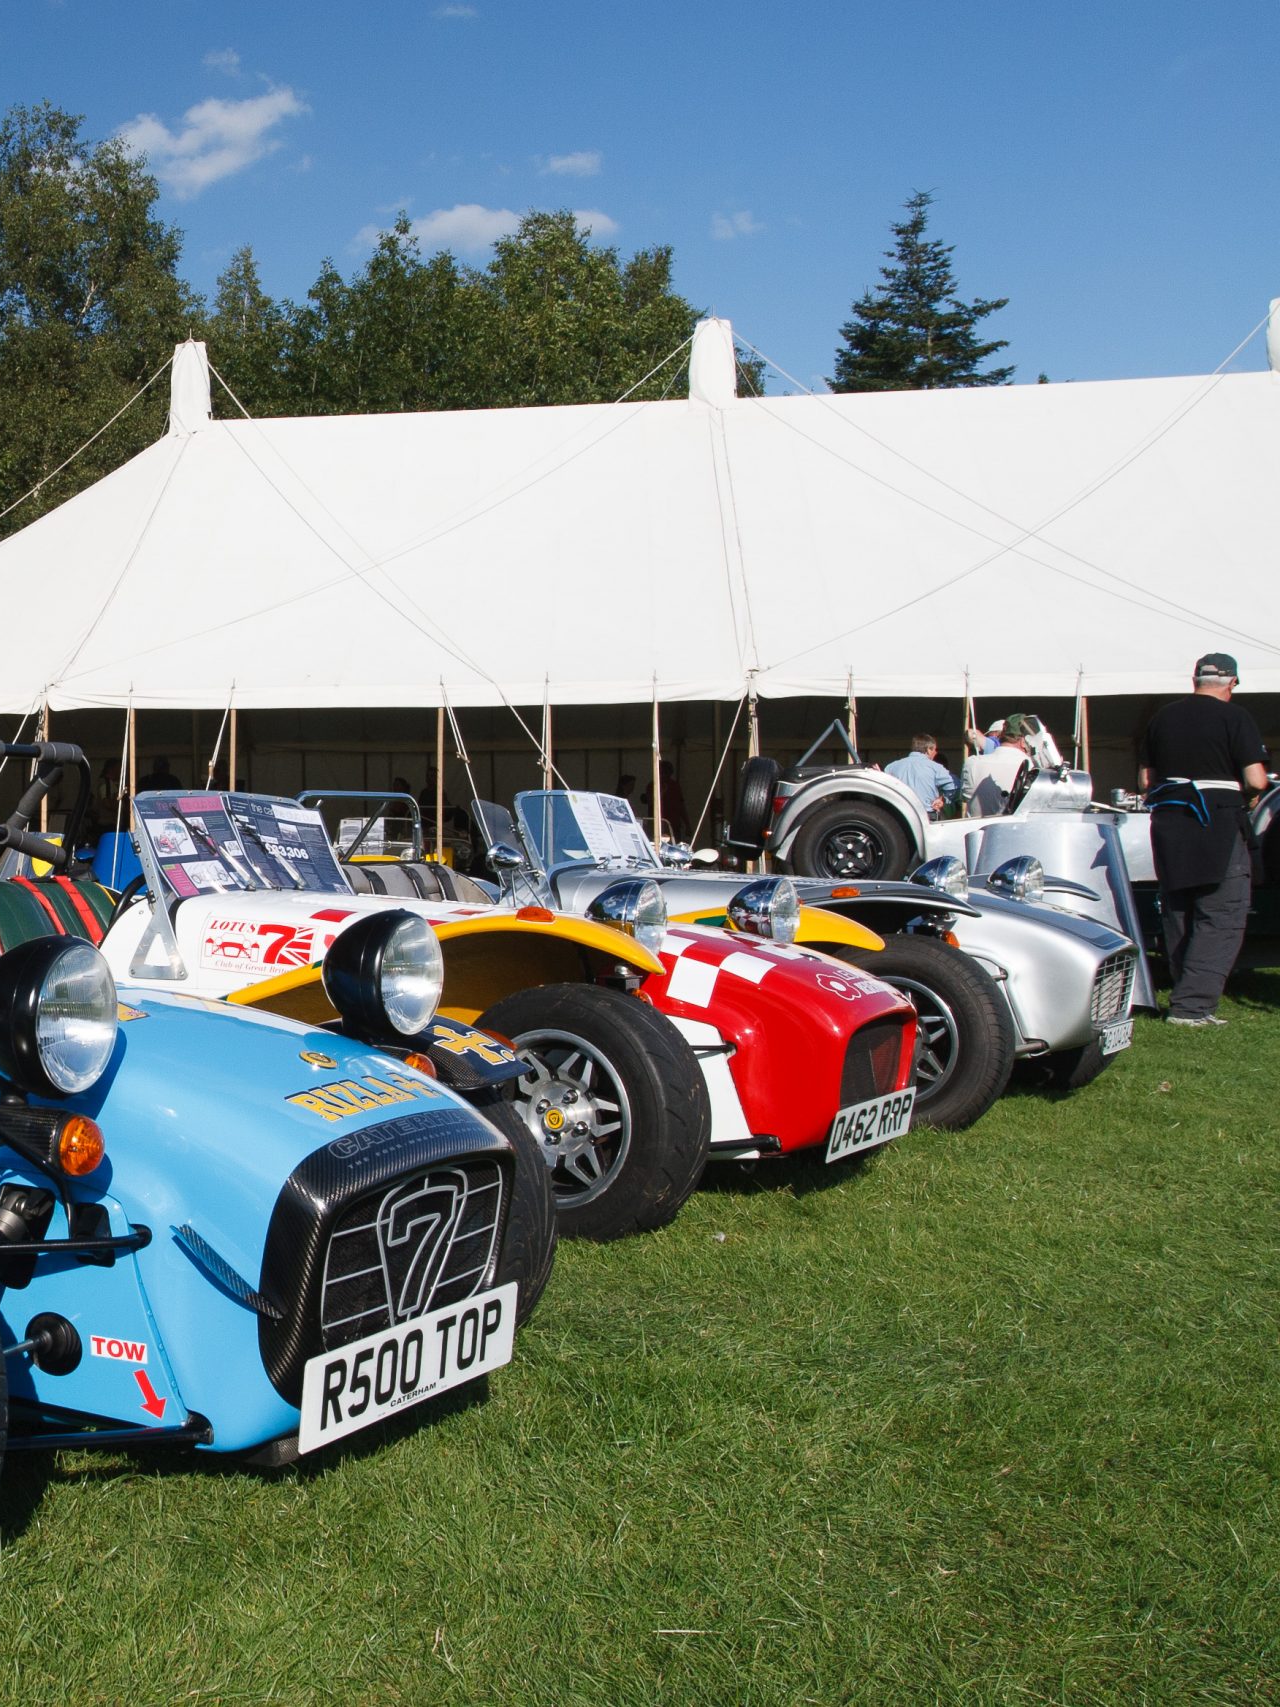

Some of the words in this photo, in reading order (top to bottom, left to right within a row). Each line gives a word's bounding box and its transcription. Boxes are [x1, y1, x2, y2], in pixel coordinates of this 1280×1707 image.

[210, 920, 258, 935] LOTUS
[258, 924, 297, 964] 7
[215, 959, 233, 968] Club
[245, 963, 267, 972] Great
[284, 1075, 418, 1123] RIZLA
[831, 1104, 879, 1155] D462
[876, 1093, 913, 1138] RRP
[92, 1336, 146, 1363] TOW
[320, 1328, 423, 1431] R500
[436, 1298, 502, 1380] TOP
[390, 1382, 437, 1407] CATERHAM
